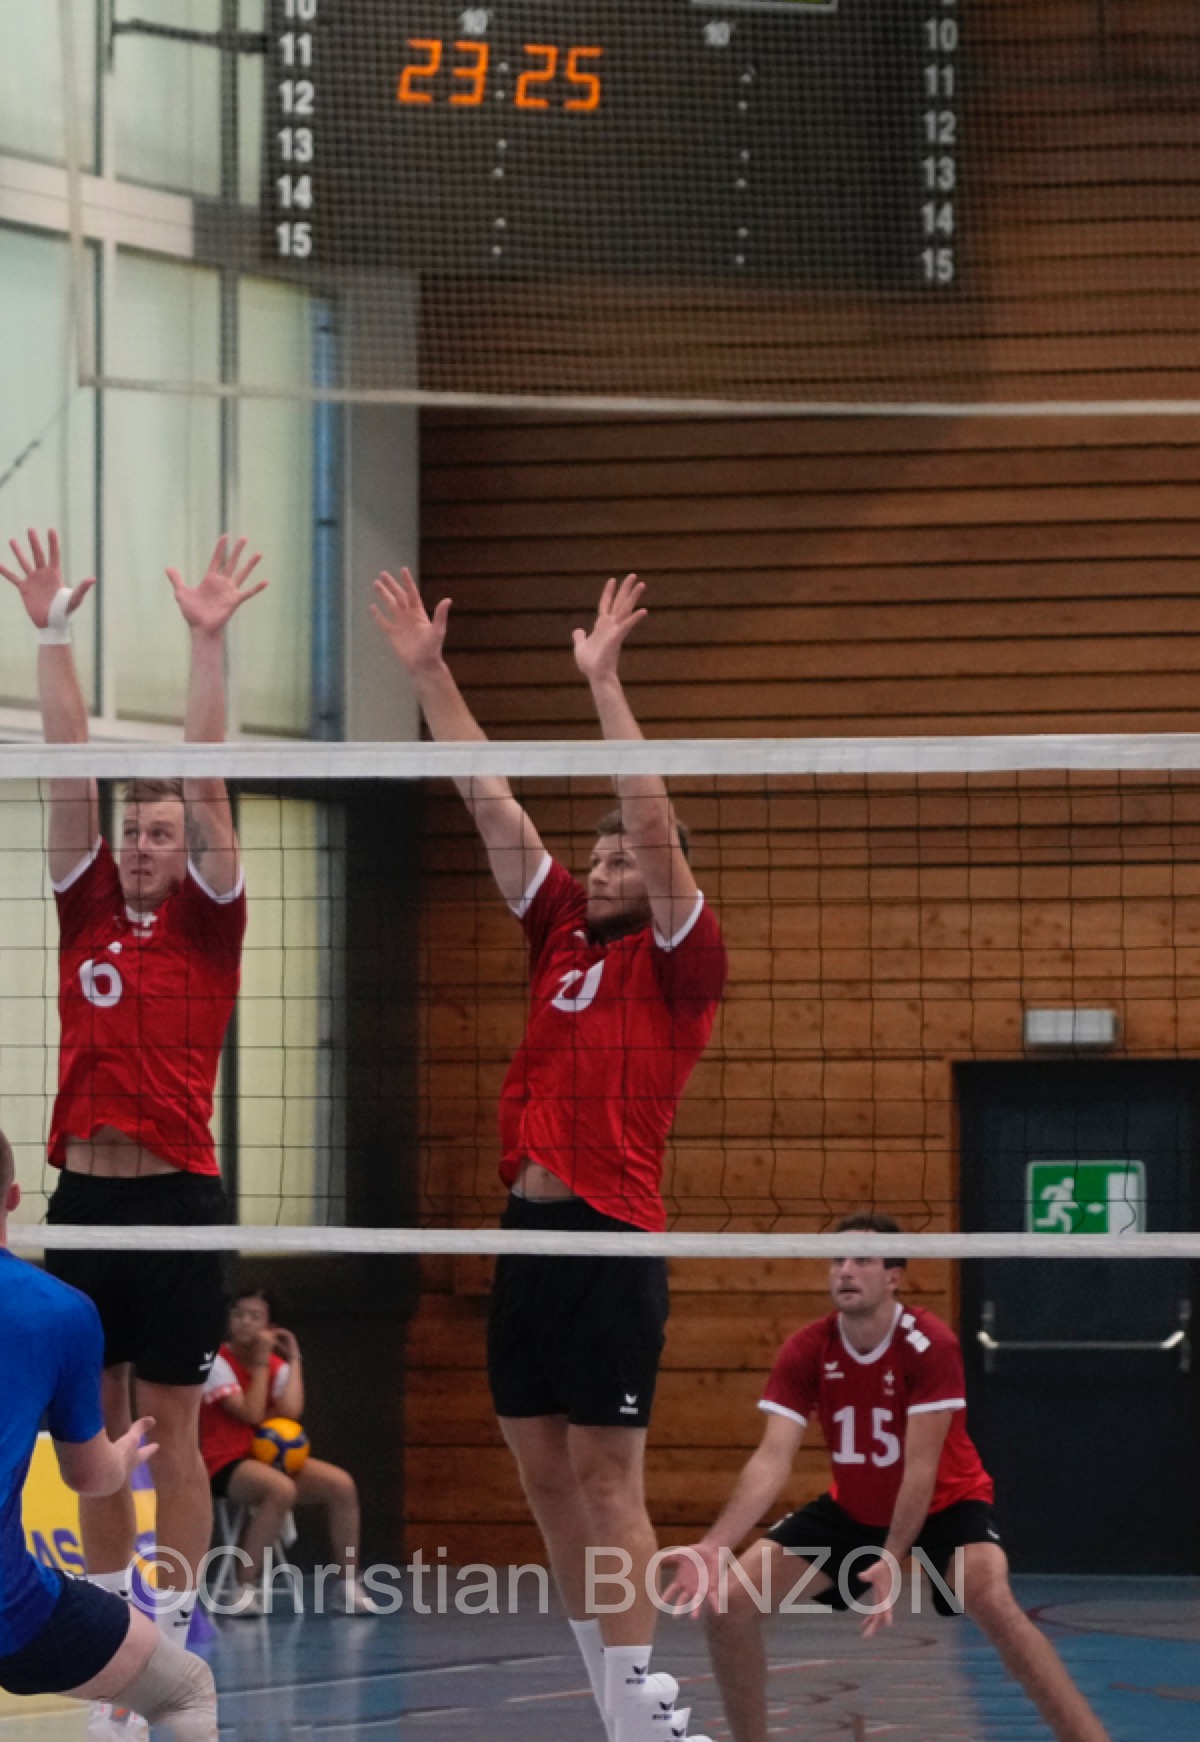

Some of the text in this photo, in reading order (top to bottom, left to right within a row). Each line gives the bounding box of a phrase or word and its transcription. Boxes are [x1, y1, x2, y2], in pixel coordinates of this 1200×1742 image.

[279, 32, 313, 66] 11
[924, 18, 958, 50] 10
[279, 81, 314, 115] 12
[924, 65, 955, 97] 11
[924, 110, 956, 144] 12
[277, 127, 314, 162] 13
[922, 156, 955, 190] 13
[276, 174, 313, 208] 14
[921, 202, 953, 235] 14
[276, 222, 313, 257] 15
[921, 248, 953, 282] 15
[79, 958, 123, 1008] 6
[832, 1405, 901, 1467] 15
